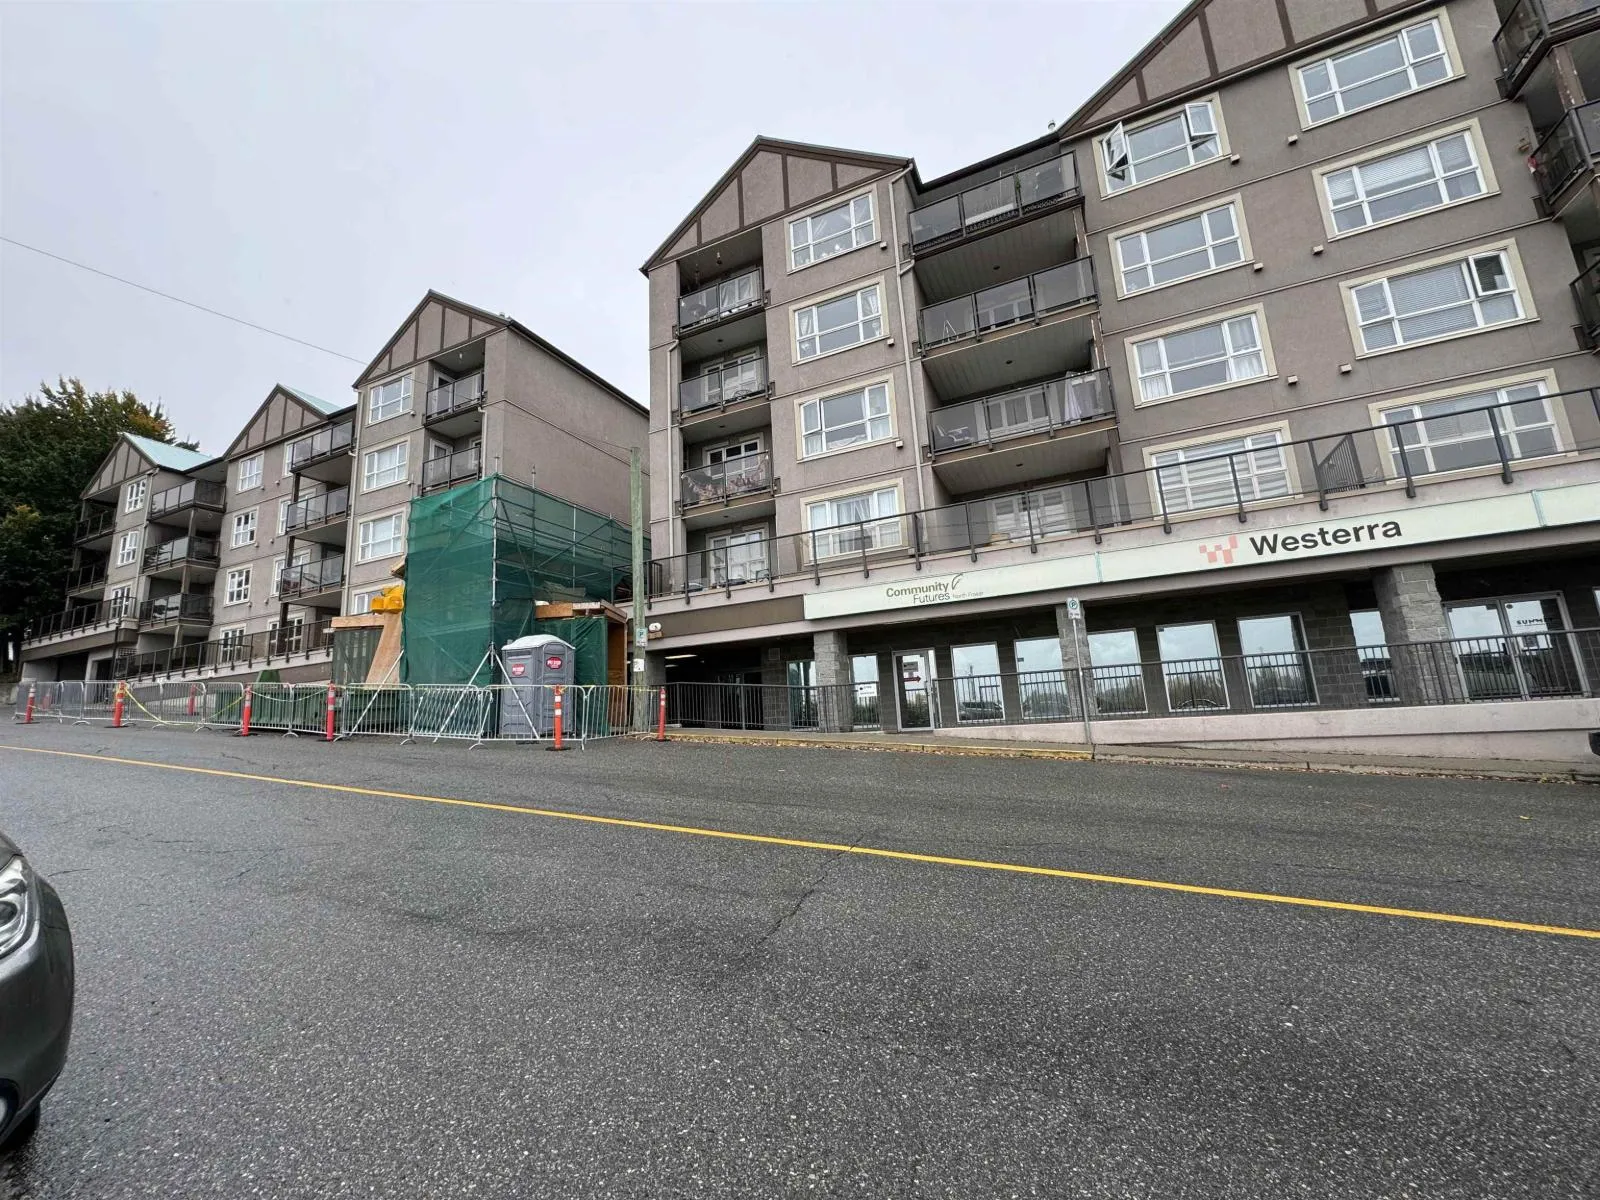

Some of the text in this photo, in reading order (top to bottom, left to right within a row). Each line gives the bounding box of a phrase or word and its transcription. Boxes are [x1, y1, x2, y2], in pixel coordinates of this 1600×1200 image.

[1249, 520, 1403, 556] Westerra
[886, 581, 950, 598] Community
[913, 592, 951, 605] Futures
